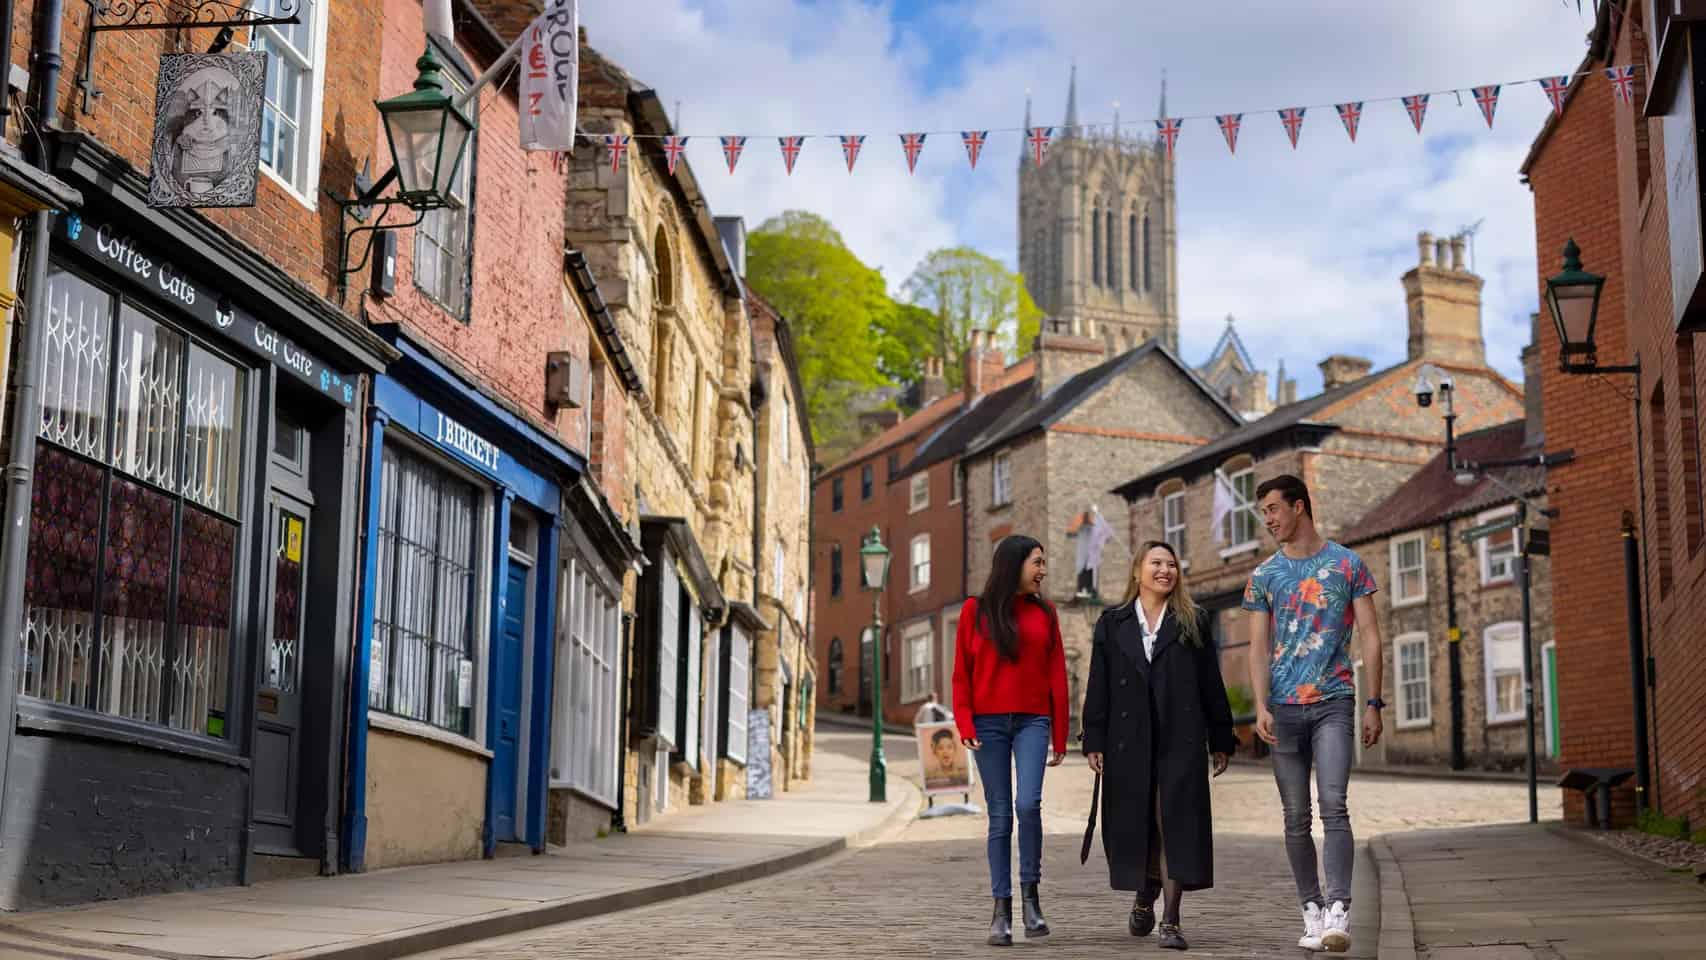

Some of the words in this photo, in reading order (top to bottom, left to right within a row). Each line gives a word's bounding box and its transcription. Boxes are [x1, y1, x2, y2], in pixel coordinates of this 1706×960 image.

[96, 223, 153, 279] Coffee
[159, 262, 195, 305] Cats
[254, 321, 279, 356] Cat
[445, 416, 500, 471] BIRKETT
